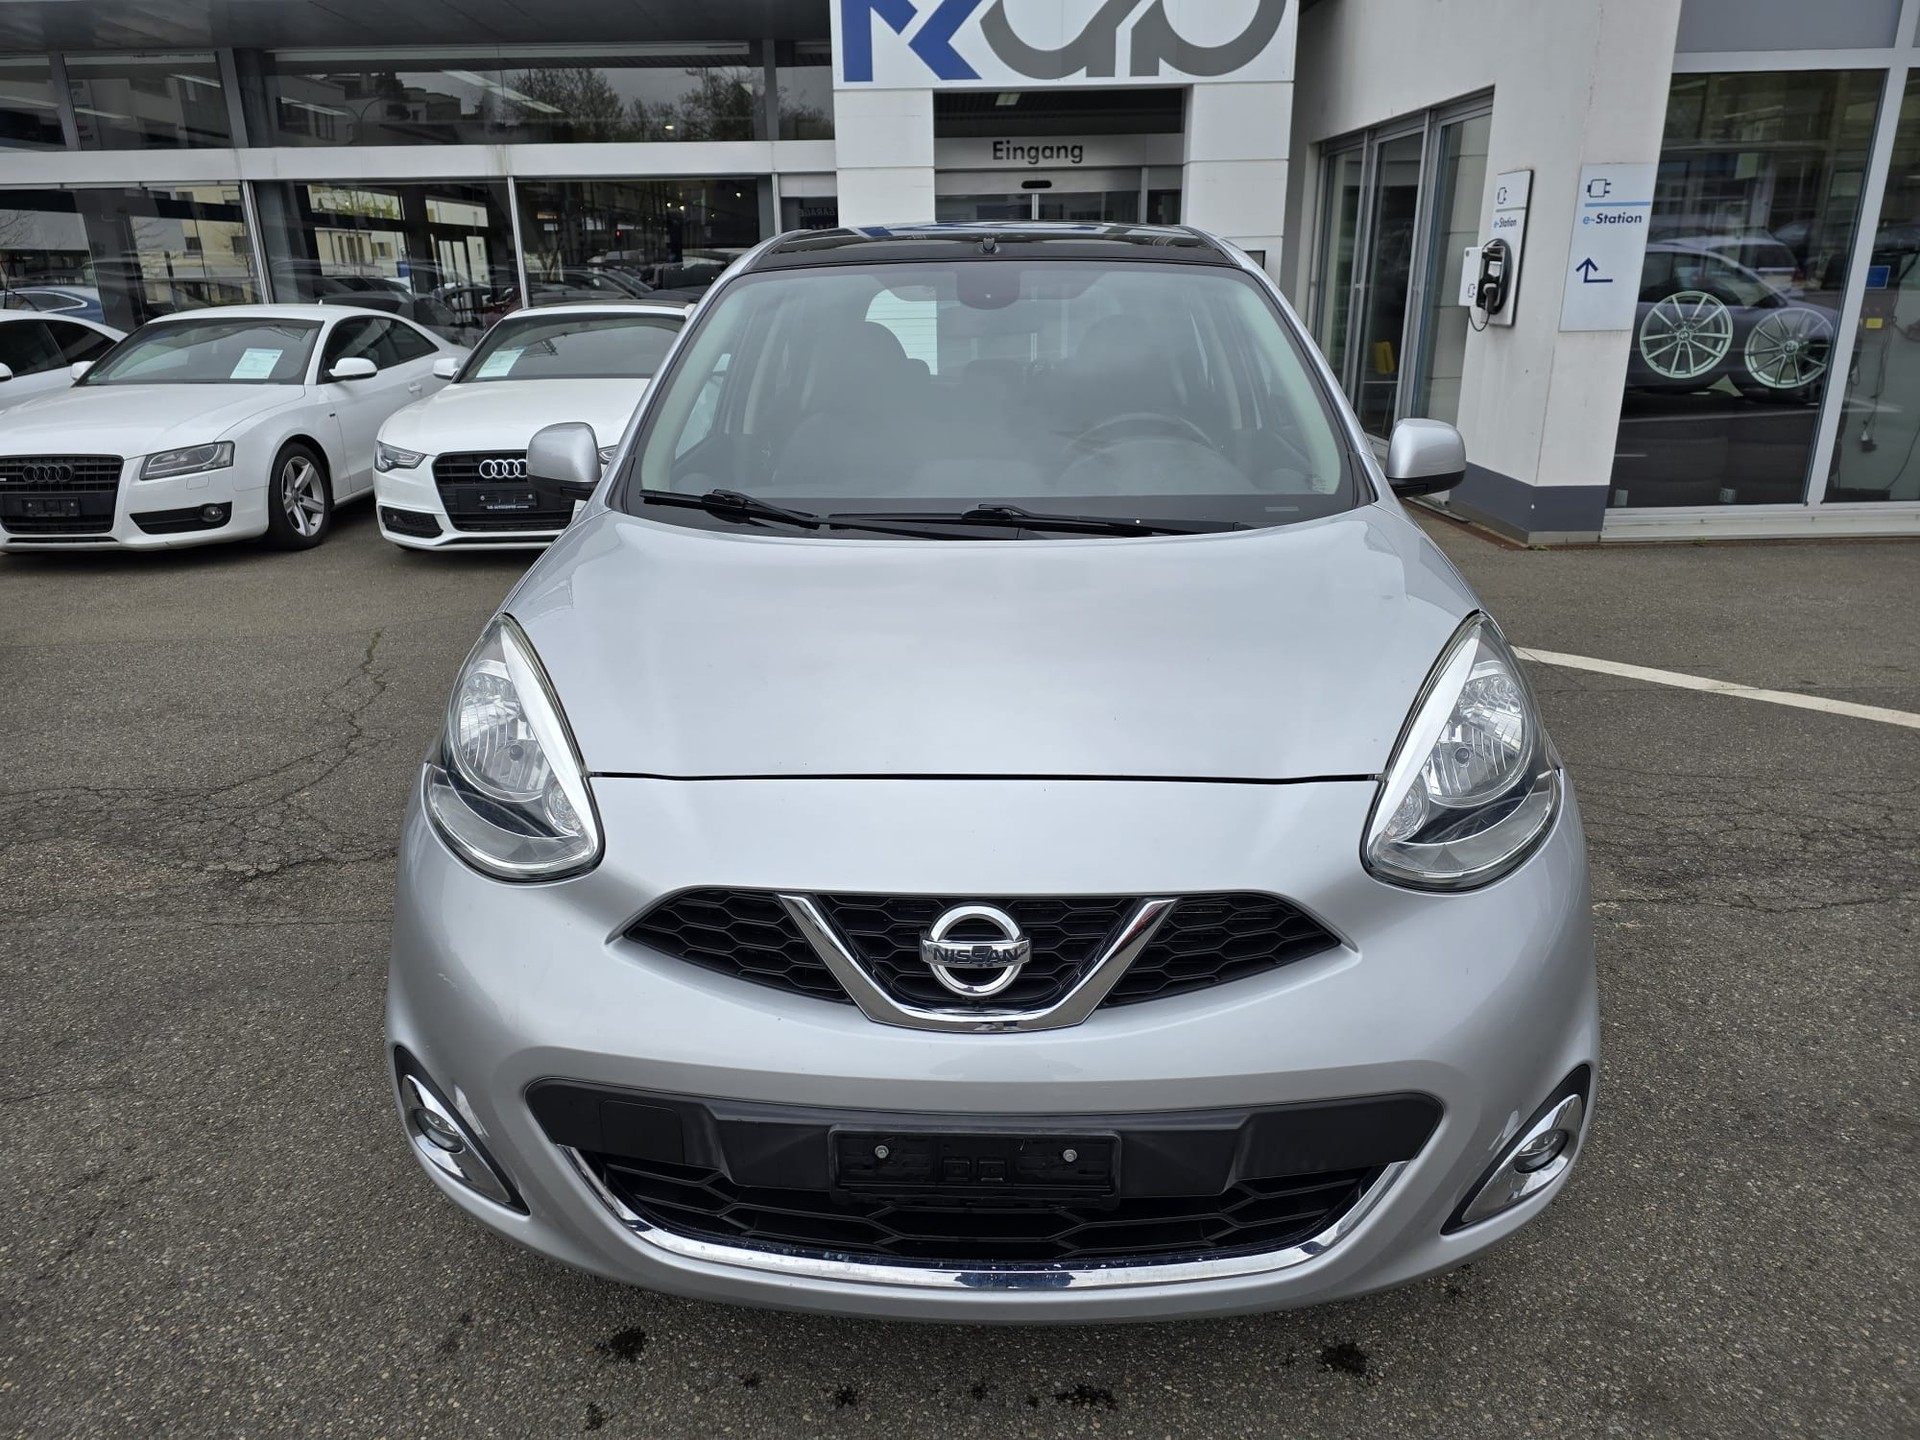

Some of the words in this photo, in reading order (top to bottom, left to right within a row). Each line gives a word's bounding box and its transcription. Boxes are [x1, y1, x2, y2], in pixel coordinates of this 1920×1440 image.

[992, 140, 1083, 164] Eingang
[1493, 217, 1517, 229] e-Station
[1582, 213, 1643, 225] e-Station
[933, 947, 1019, 964] NISSAN
